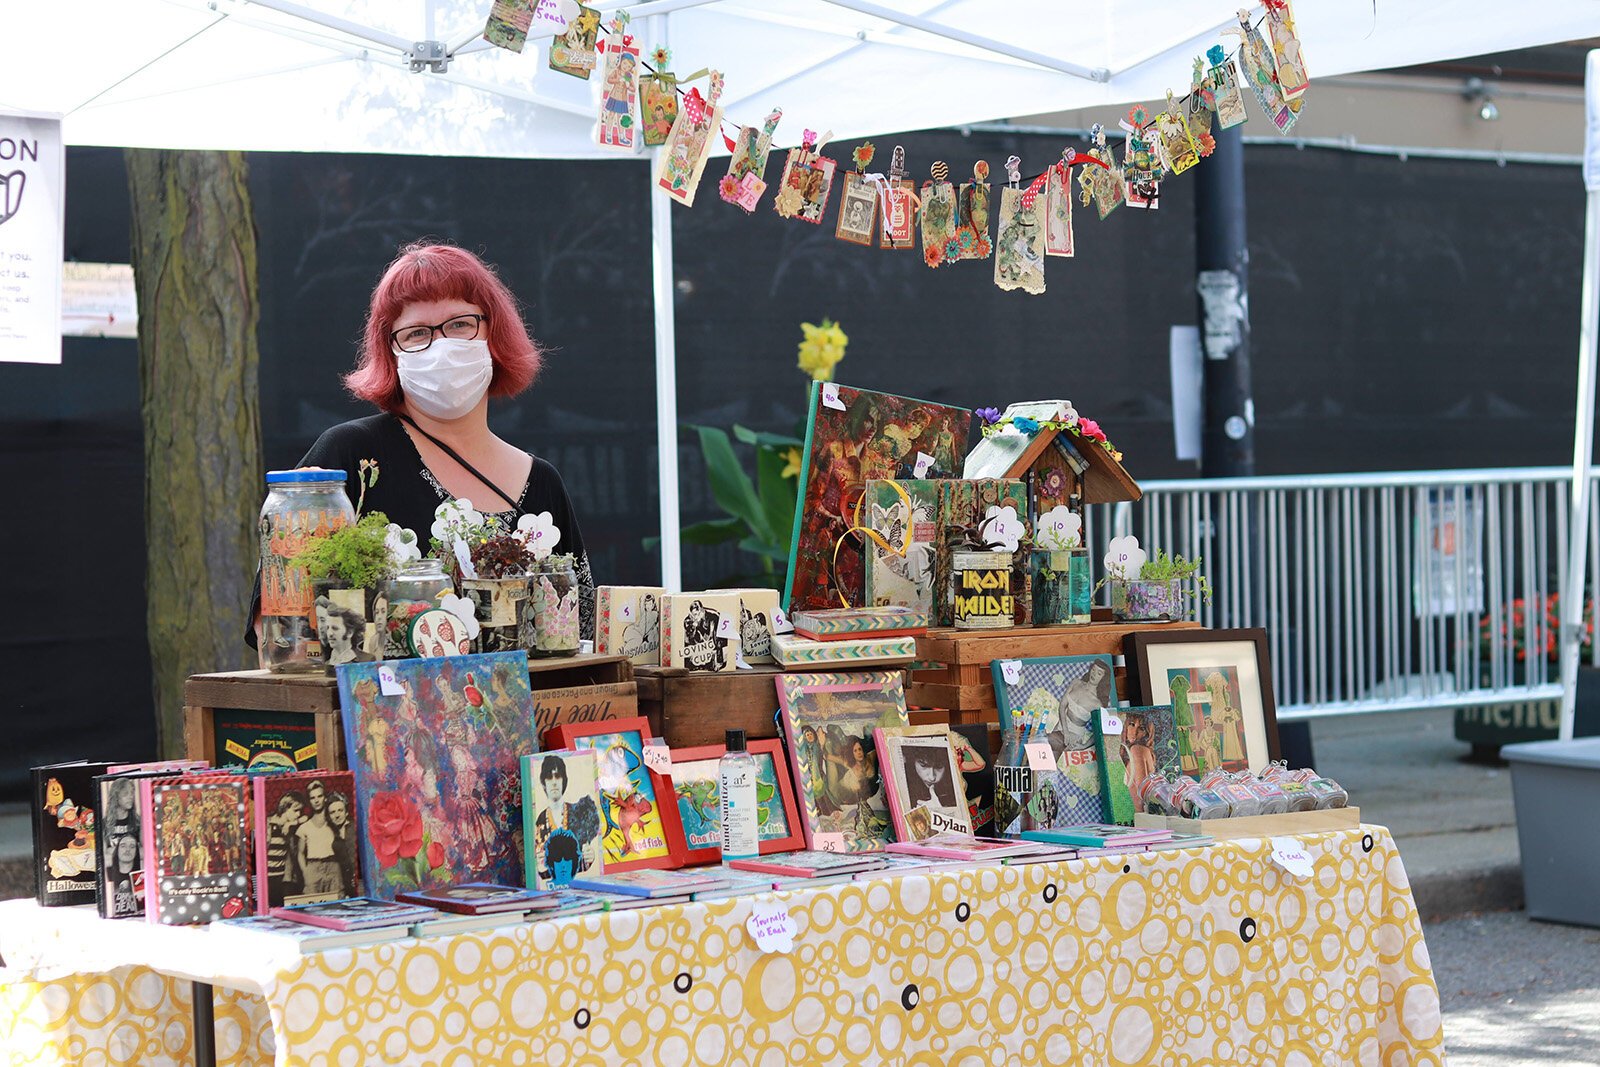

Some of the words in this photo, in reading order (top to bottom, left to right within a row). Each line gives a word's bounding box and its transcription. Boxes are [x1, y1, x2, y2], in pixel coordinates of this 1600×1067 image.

[537, 7, 544, 19] 5
[544, 13, 566, 25] each
[994, 521, 1005, 534] 12
[1053, 521, 1064, 531] 10
[1119, 553, 1128, 562] 10
[962, 570, 1010, 594] IRON
[624, 606, 630, 617] 5
[721, 620, 730, 631] 5
[775, 614, 784, 626] 5
[678, 641, 715, 658] LOVING
[1038, 751, 1047, 760] 12
[766, 824, 784, 834] fish
[932, 813, 968, 834] Dylan
[635, 838, 647, 849] red
[647, 838, 663, 849] fish
[690, 834, 707, 844] One
[708, 832, 721, 843] fis
[823, 840, 835, 852] 25
[766, 924, 787, 936] Each
